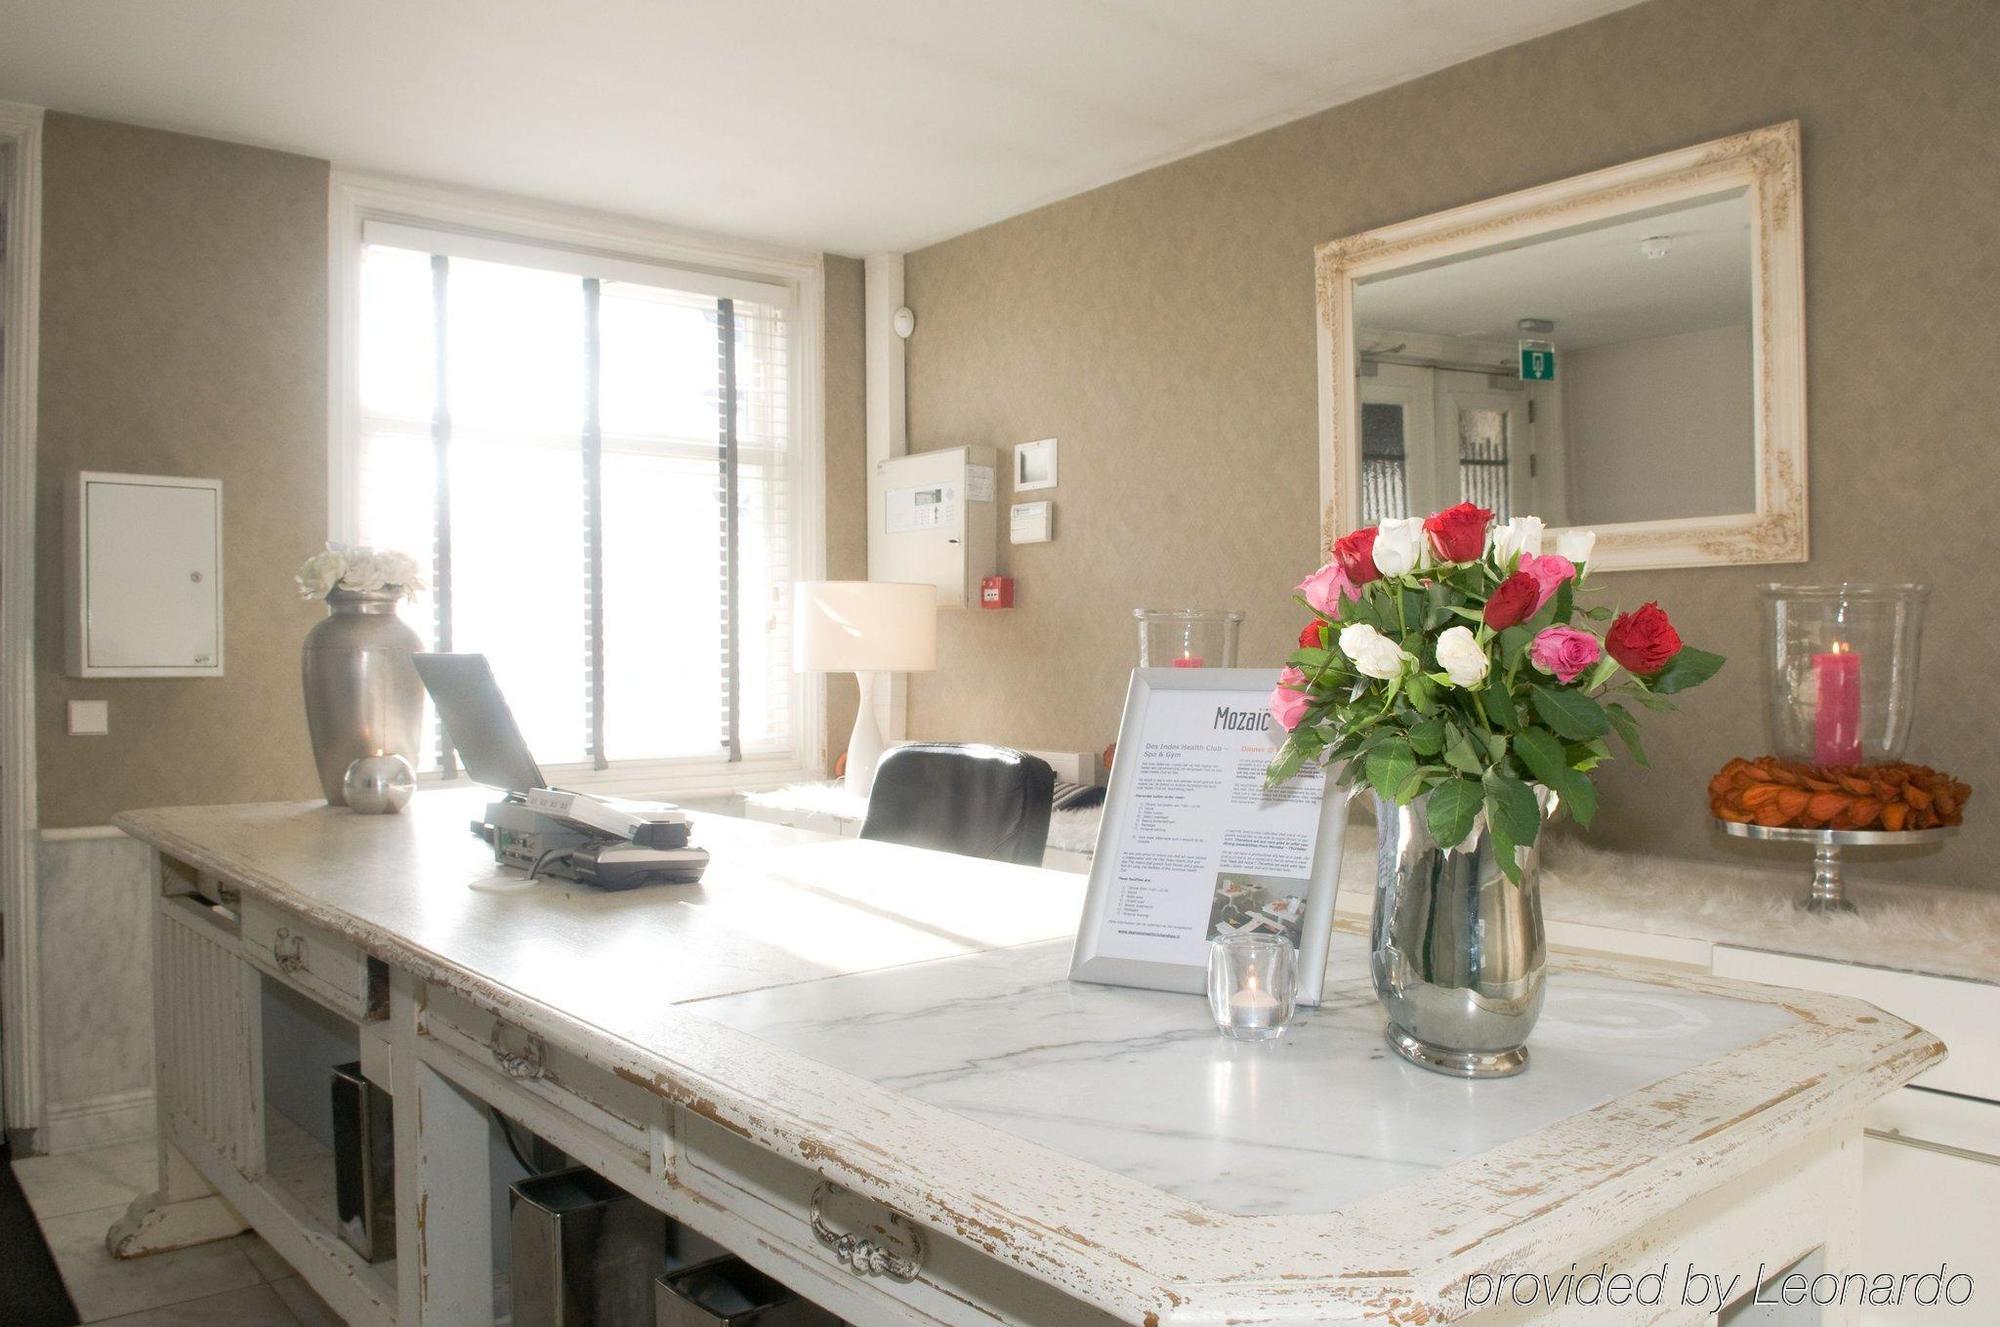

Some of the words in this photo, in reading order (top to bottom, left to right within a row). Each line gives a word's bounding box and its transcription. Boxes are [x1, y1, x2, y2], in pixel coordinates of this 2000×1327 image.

[1181, 743, 1204, 751] Health
[1205, 744, 1223, 752] Club
[1143, 750, 1157, 759] Spa
[1165, 751, 1182, 759] Gym
